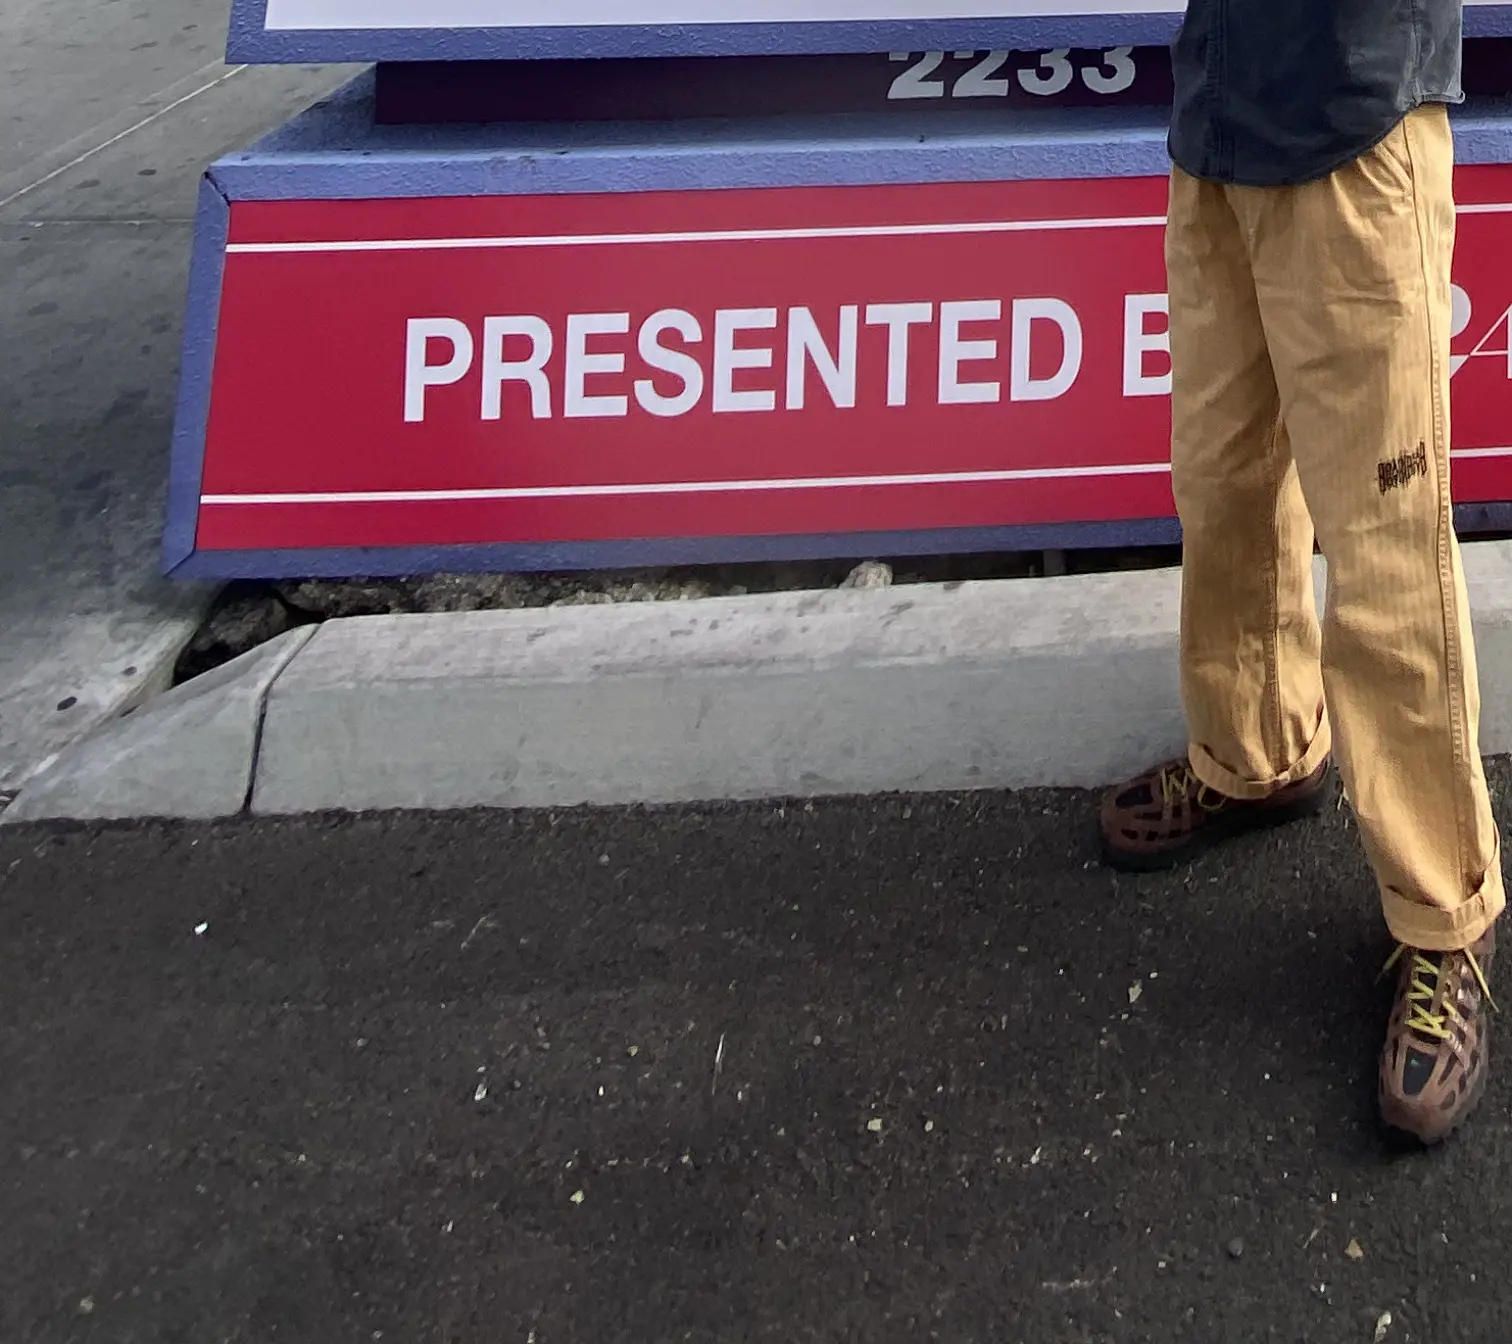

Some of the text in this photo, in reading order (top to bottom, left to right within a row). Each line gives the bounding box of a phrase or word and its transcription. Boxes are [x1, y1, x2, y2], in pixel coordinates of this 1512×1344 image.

[887, 46, 1136, 100] 2233
[404, 294, 1173, 422] PRESENTED B
